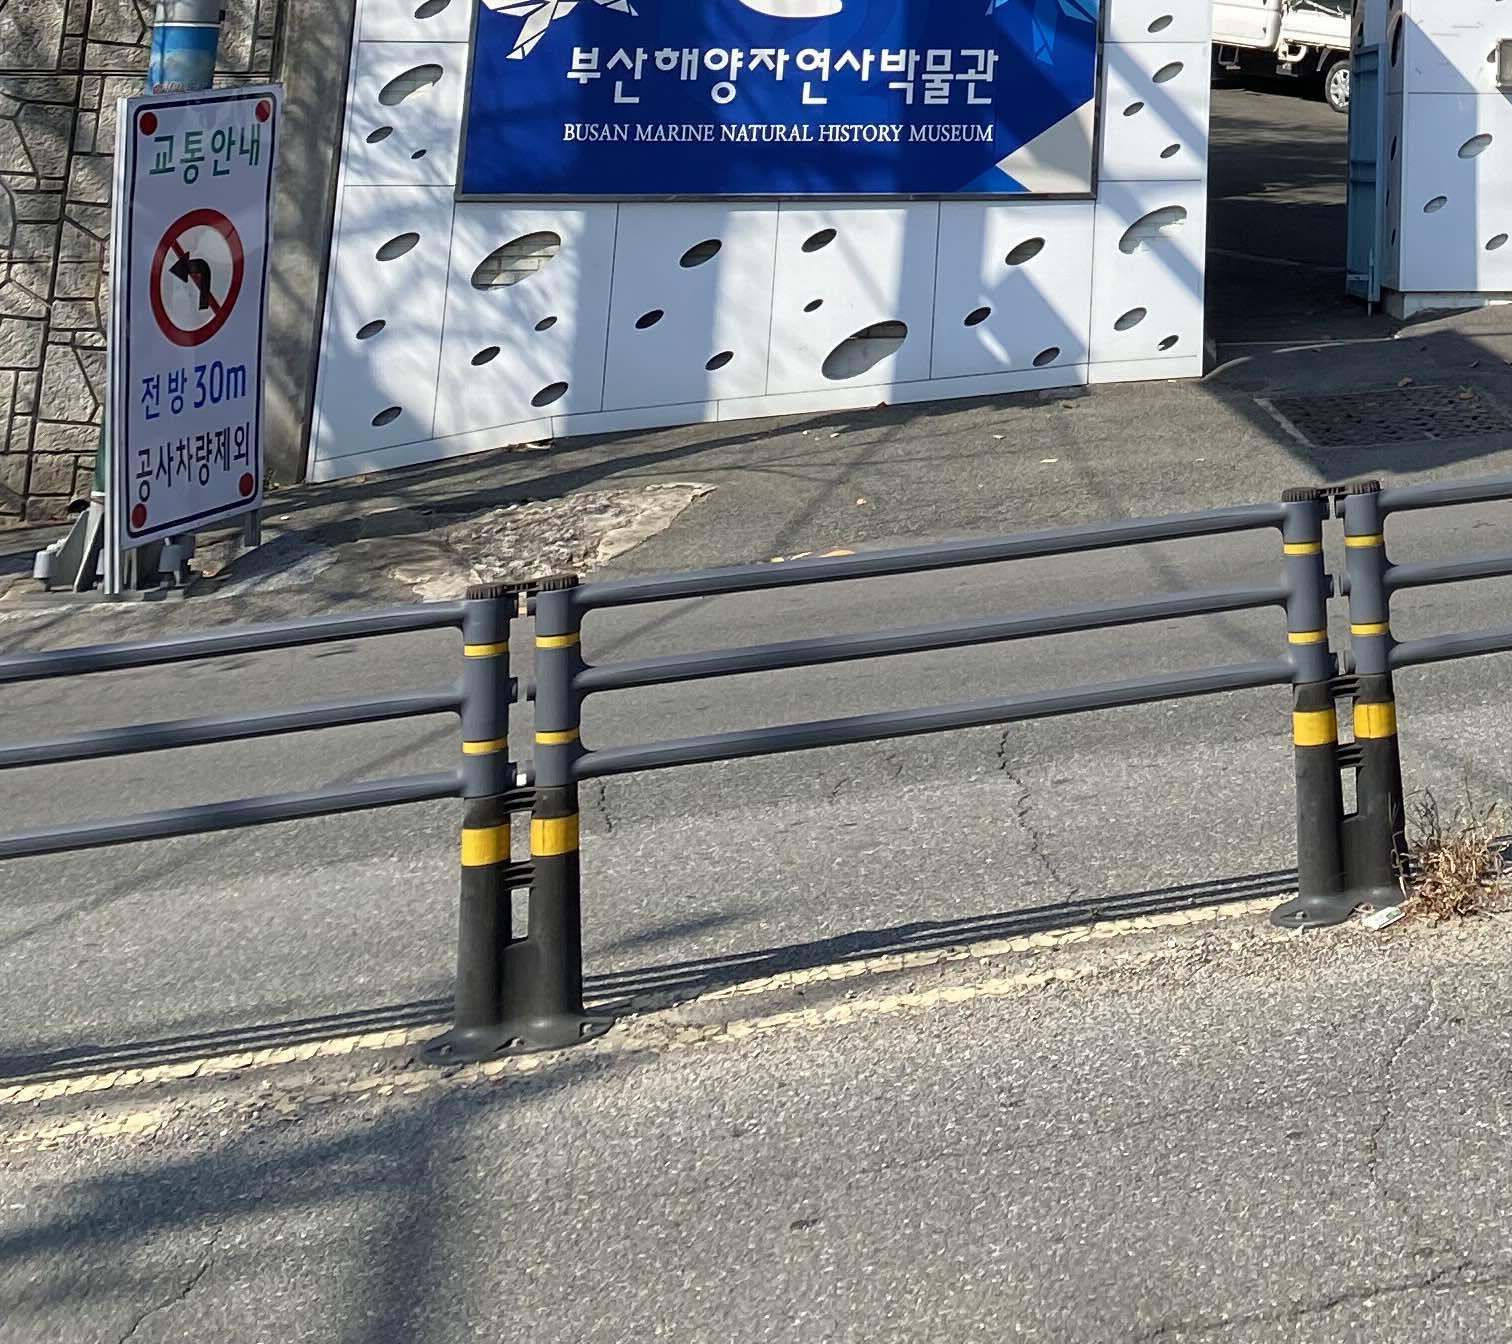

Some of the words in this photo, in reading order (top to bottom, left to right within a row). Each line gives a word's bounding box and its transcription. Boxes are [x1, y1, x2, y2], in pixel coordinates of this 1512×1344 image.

[567, 47, 998, 105] 부산해양자연사박물관
[149, 123, 261, 185] 교통안내
[563, 123, 629, 142] BUSAN
[634, 123, 714, 142] MARINE
[720, 123, 813, 142] NATURAL
[819, 123, 903, 143] HISTORY
[908, 123, 993, 143] MUSEUM
[193, 361, 246, 409] 30m
[136, 422, 250, 502] 공사차량제외
